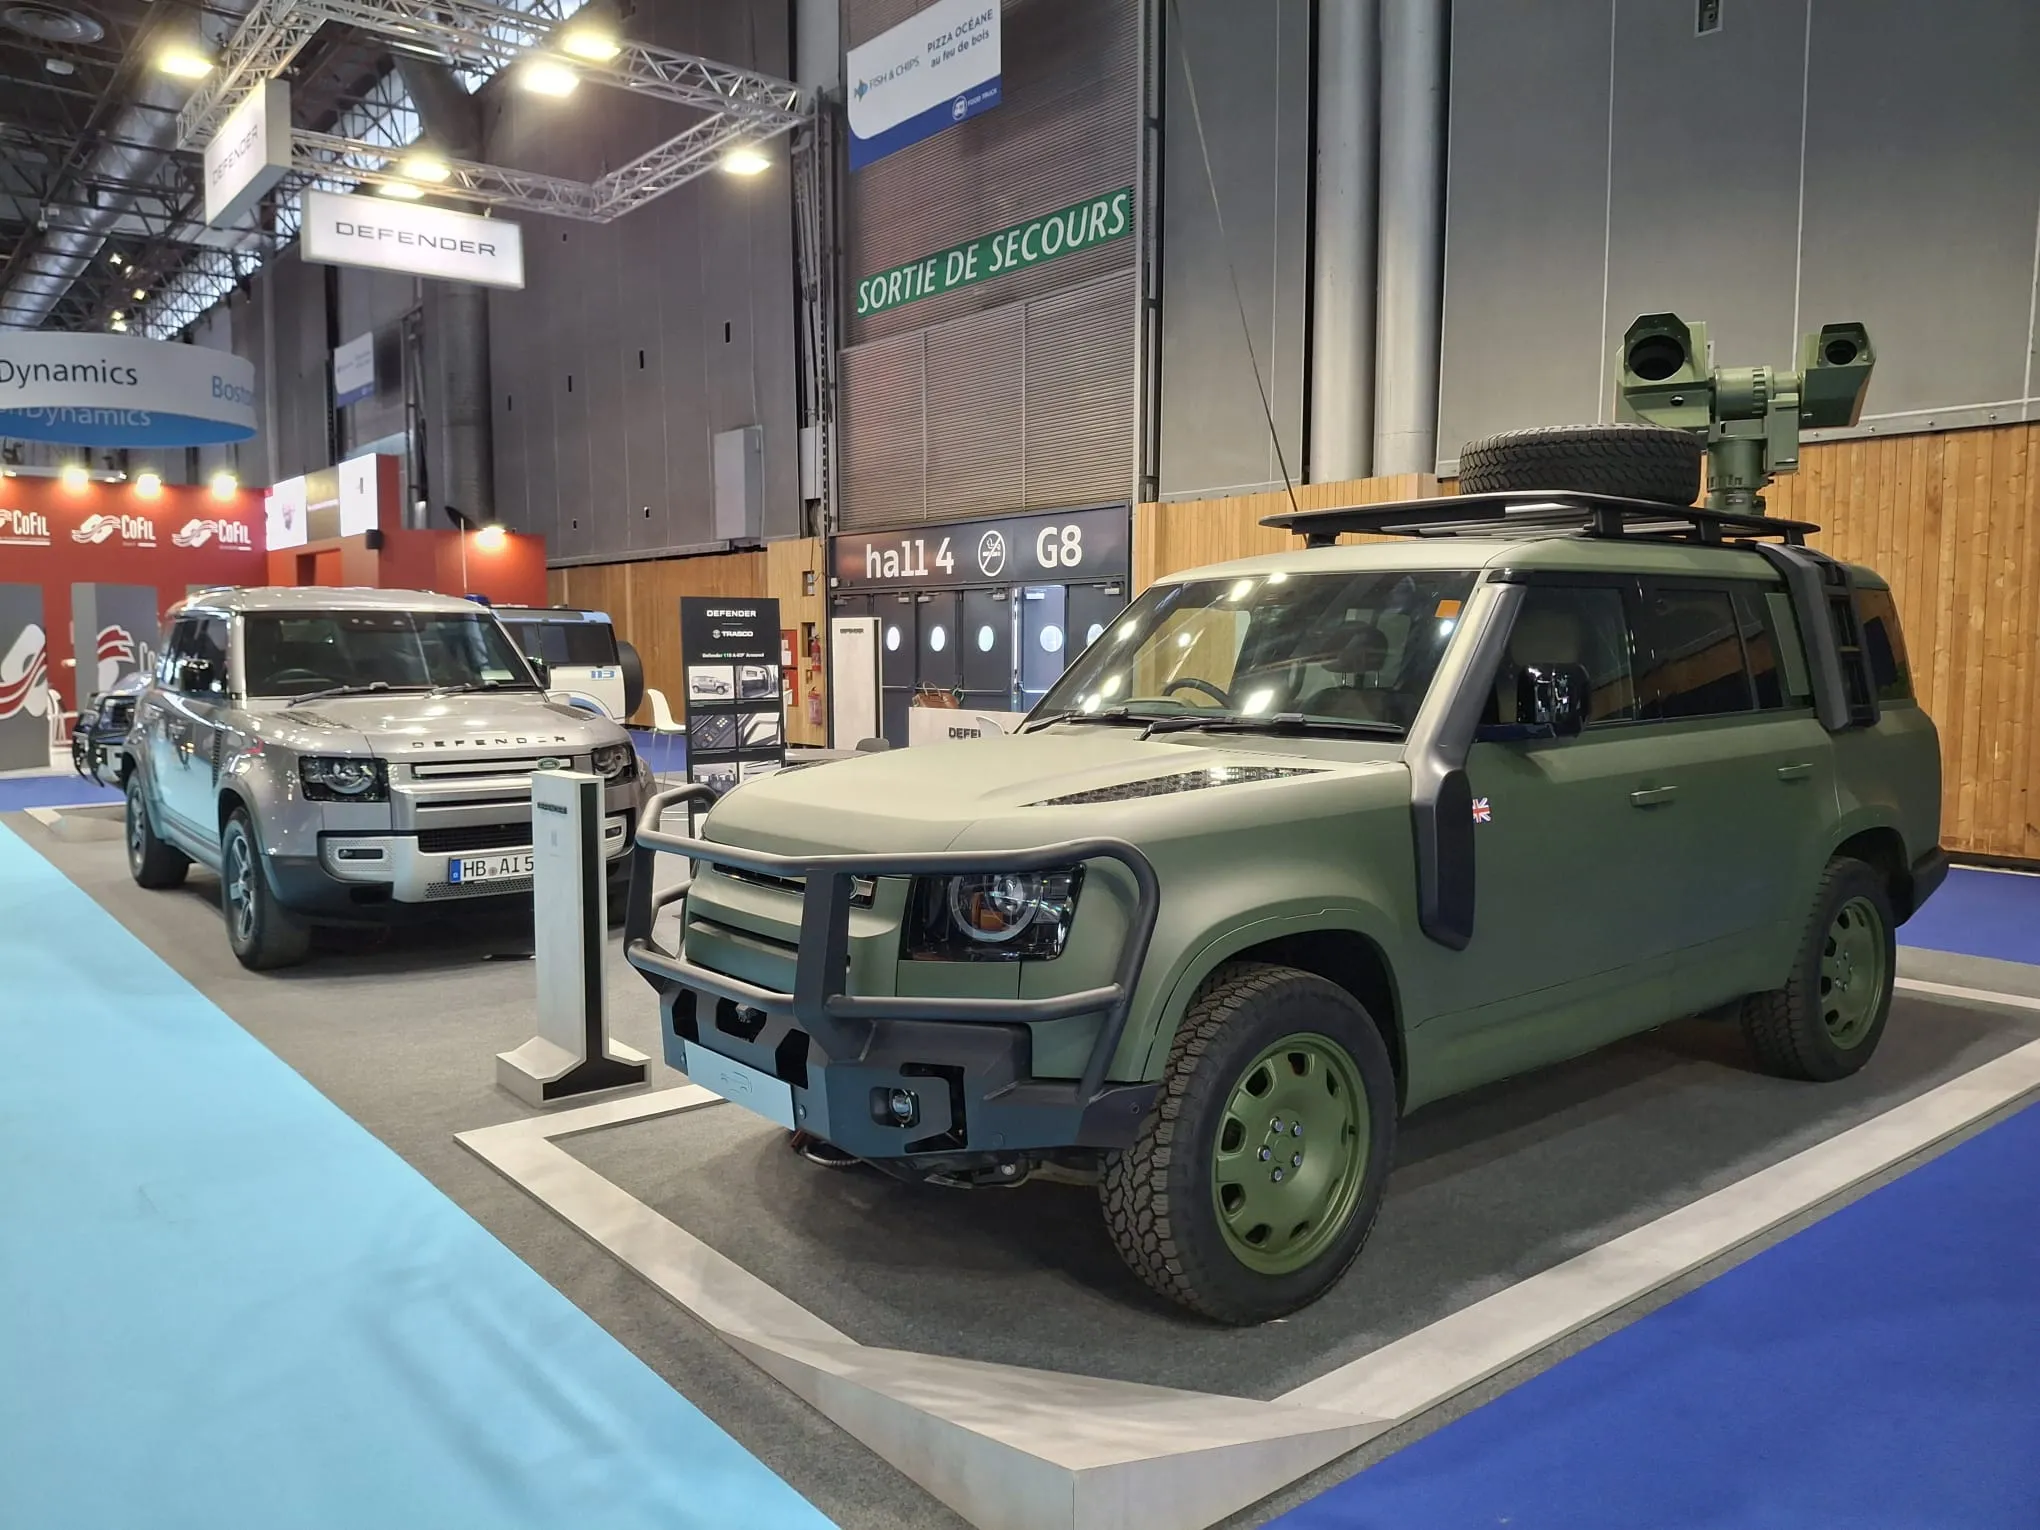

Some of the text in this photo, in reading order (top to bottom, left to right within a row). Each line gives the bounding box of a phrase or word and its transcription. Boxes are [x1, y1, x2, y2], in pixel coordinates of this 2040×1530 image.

[927, 9, 993, 53] PIZZA OCÉANE
[930, 29, 990, 68] au feu de bois
[869, 56, 920, 90] FISH & CHIPS
[212, 123, 258, 187] DEFENDER
[335, 221, 497, 257] DEFENDER
[857, 193, 1127, 314] SORTIE DE SECOURS
[0, 360, 139, 389] Dynamics
[866, 537, 954, 579] hall 4
[1036, 524, 1083, 569] G8
[706, 609, 757, 618] DEFENDER
[463, 860, 487, 878] HB
[499, 857, 520, 875] AI
